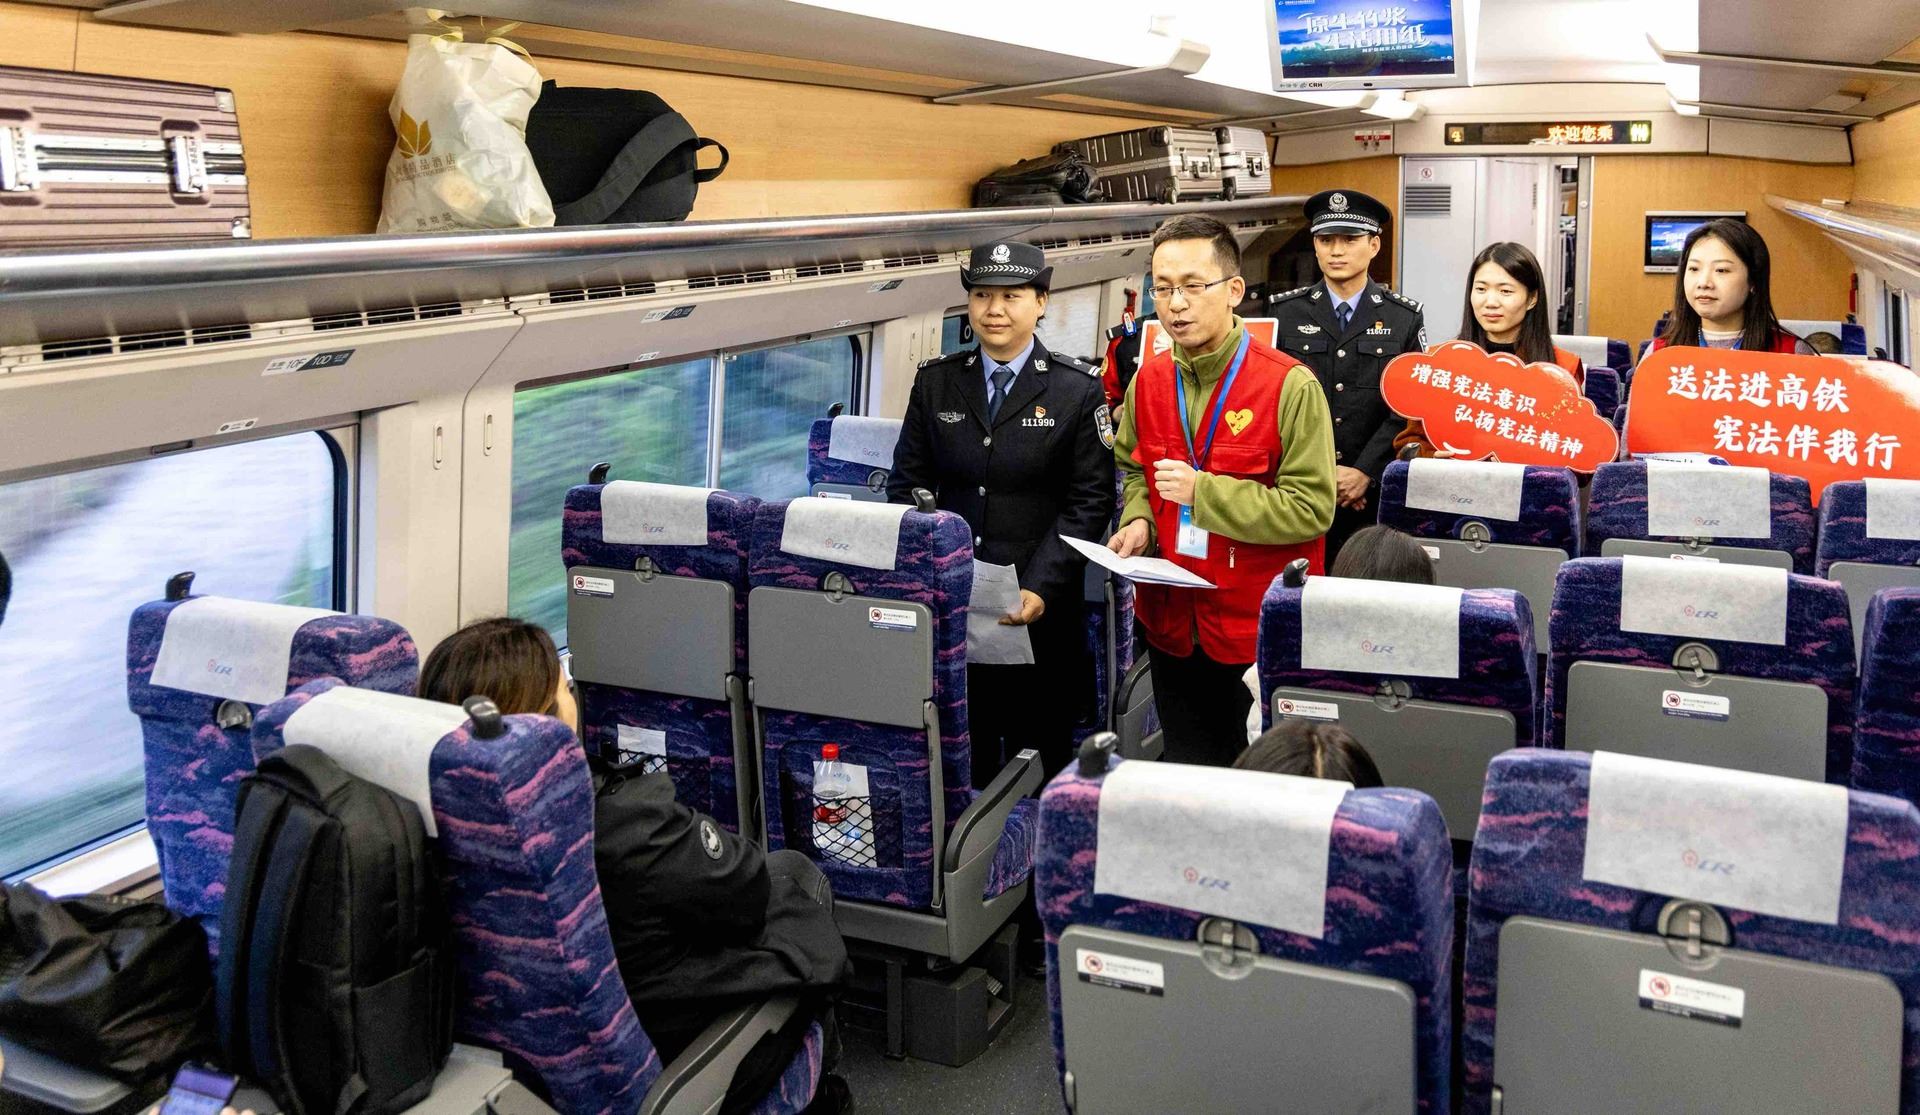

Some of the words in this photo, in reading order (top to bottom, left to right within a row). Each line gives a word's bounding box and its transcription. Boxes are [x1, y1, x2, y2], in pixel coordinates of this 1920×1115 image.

[1304, 6, 1408, 34] 原生竹浆
[1326, 23, 1426, 50] 生活用纸
[1451, 131, 1461, 143] 4
[1410, 362, 1538, 416] 增强宪法意识
[1666, 364, 1850, 413] 送法进高铁
[1021, 418, 1055, 427] 111990
[1454, 403, 1584, 460] 弘扬宪法精神
[1712, 414, 1902, 471] 宪法伴我行
